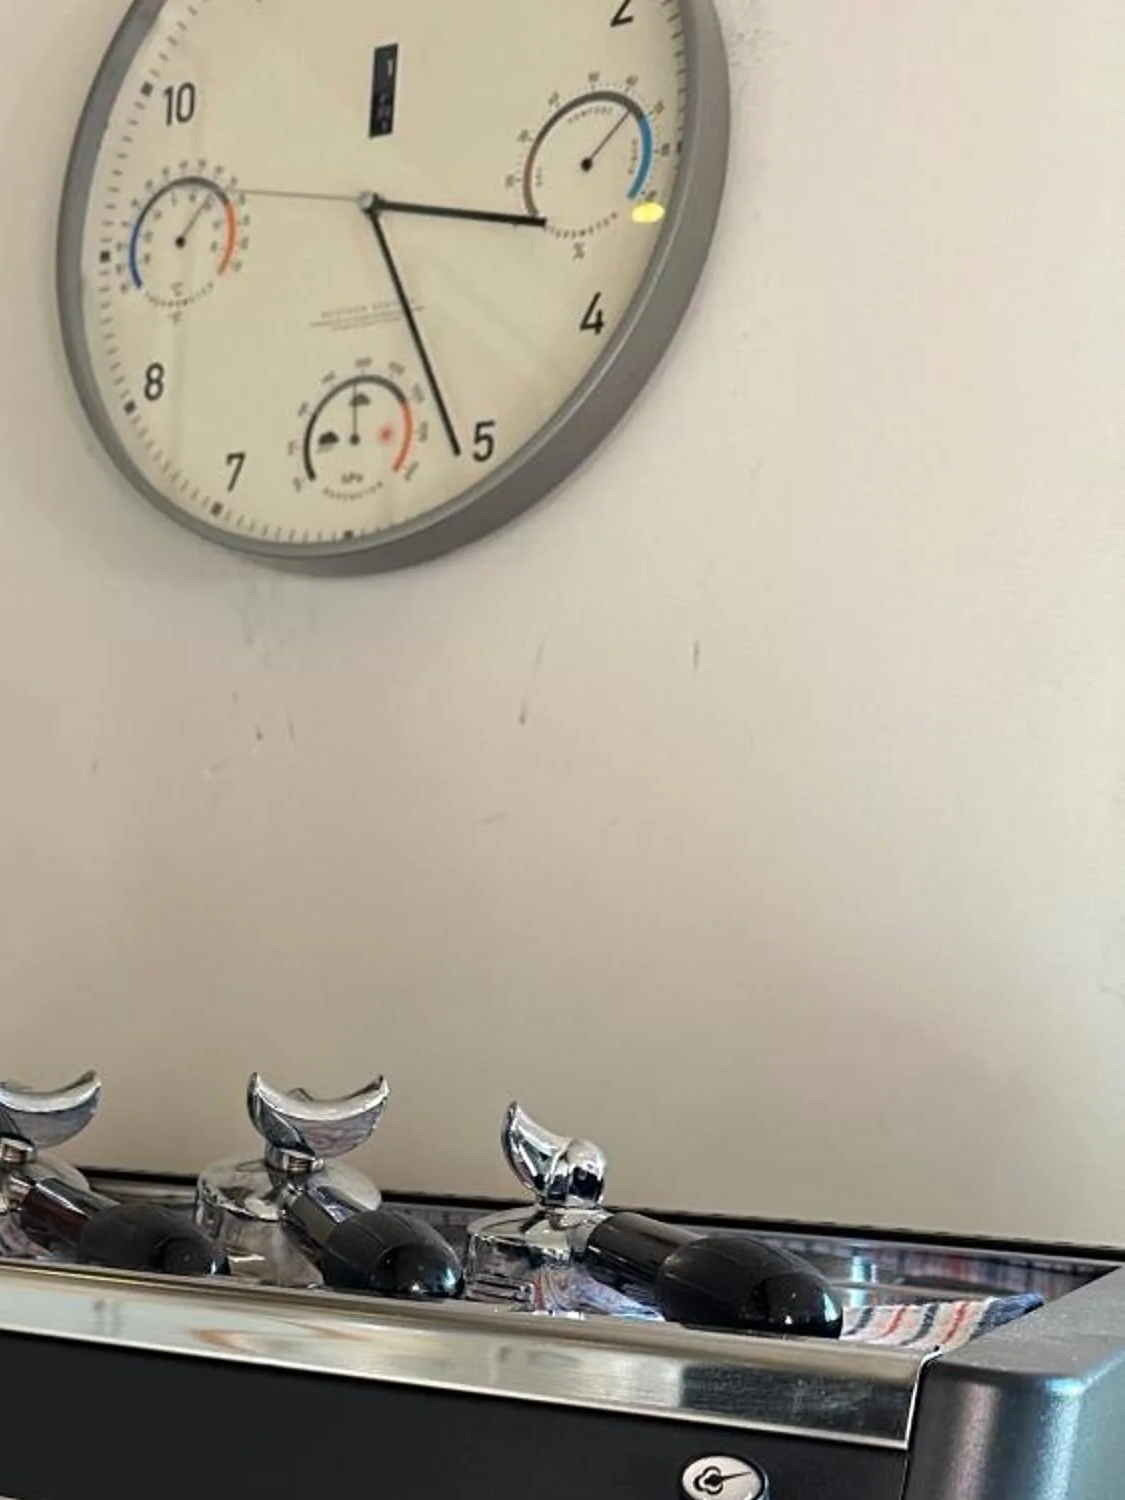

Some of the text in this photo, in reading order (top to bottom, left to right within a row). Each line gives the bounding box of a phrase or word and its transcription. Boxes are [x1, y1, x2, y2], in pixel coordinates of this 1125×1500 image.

[163, 82, 196, 127] 10
[579, 291, 605, 336] 4
[144, 362, 164, 401] 8
[472, 420, 496, 462] 5
[226, 452, 246, 493] 7
